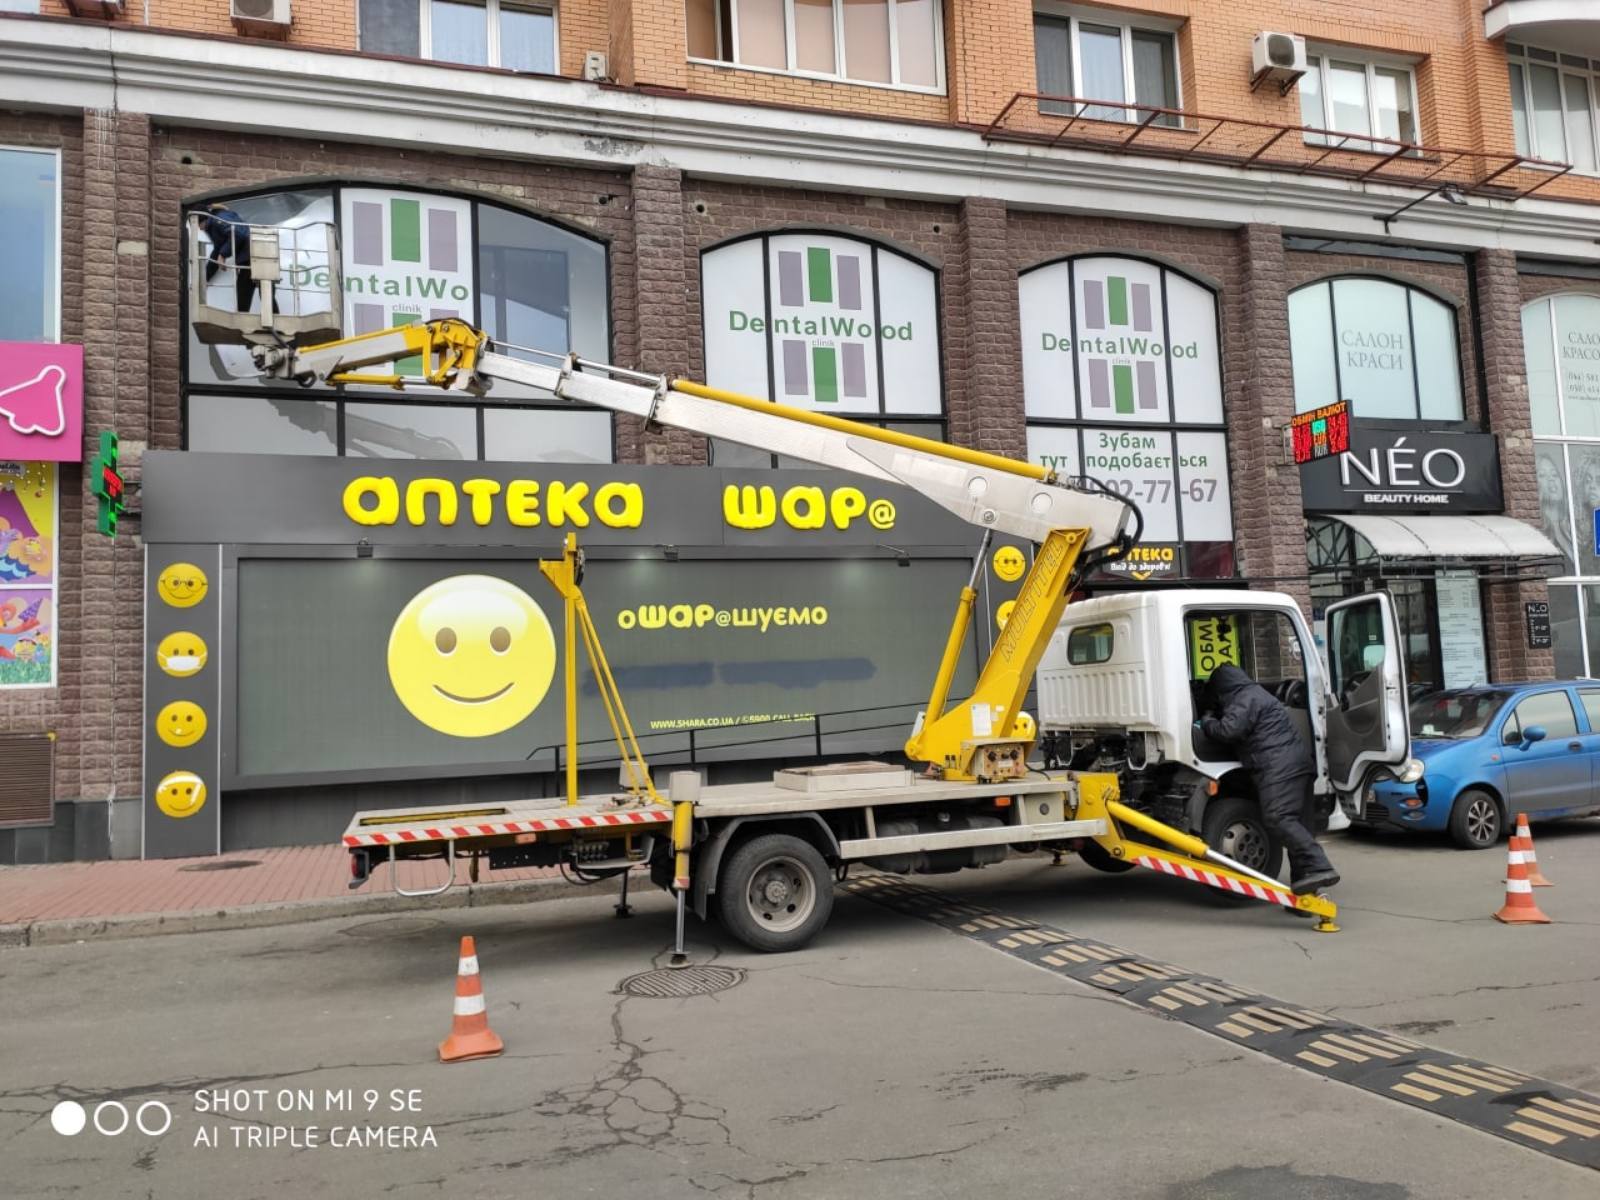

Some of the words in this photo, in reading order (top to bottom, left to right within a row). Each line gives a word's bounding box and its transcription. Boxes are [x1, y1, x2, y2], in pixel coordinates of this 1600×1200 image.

[392, 303, 421, 312] clinik
[729, 310, 912, 341] DentalWood
[1042, 333, 1198, 359] DentalWood
[1341, 329, 1405, 349] САЛОН
[1347, 352, 1404, 370] КРАСИ
[1099, 432, 1156, 451] Зубам
[1040, 455, 1067, 469] тут
[1087, 452, 1207, 471] подобається
[1340, 436, 1466, 488] NÉO
[1363, 493, 1412, 503] BEAUTY
[1413, 494, 1449, 503] HOME
[650, 716, 734, 729] WWW.SHARA.CO.UA
